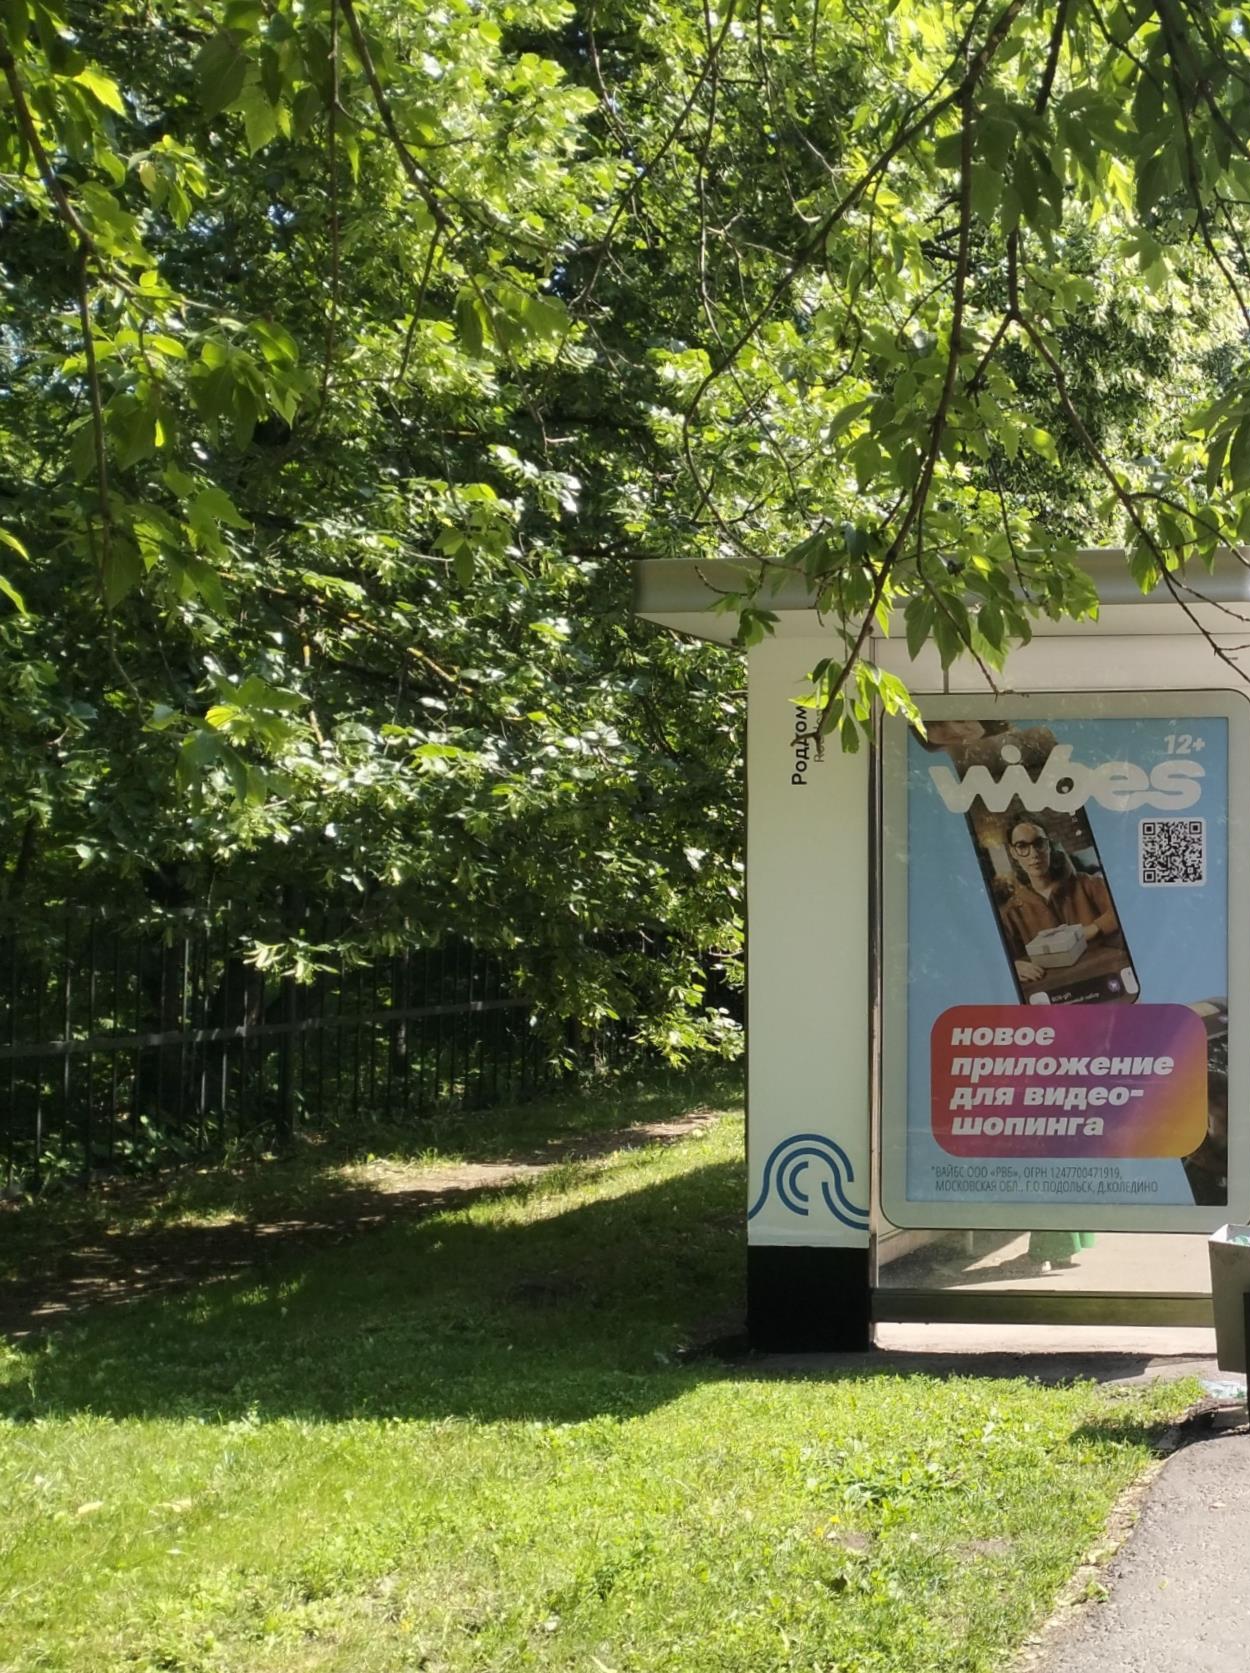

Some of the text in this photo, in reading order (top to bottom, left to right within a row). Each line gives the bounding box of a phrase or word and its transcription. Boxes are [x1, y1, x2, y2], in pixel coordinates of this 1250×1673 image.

[1164, 735, 1206, 754] 12+
[928, 744, 1206, 813] vibes
[951, 1026, 1056, 1046] новое
[950, 1056, 1175, 1083] приложение
[949, 1086, 1145, 1110] для видео-
[951, 1117, 1105, 1136] шопинга
[966, 1166, 989, 1179] ООО
[1023, 1166, 1048, 1179] ОГРН
[935, 1179, 997, 1193] МОСКОВСКАЯ
